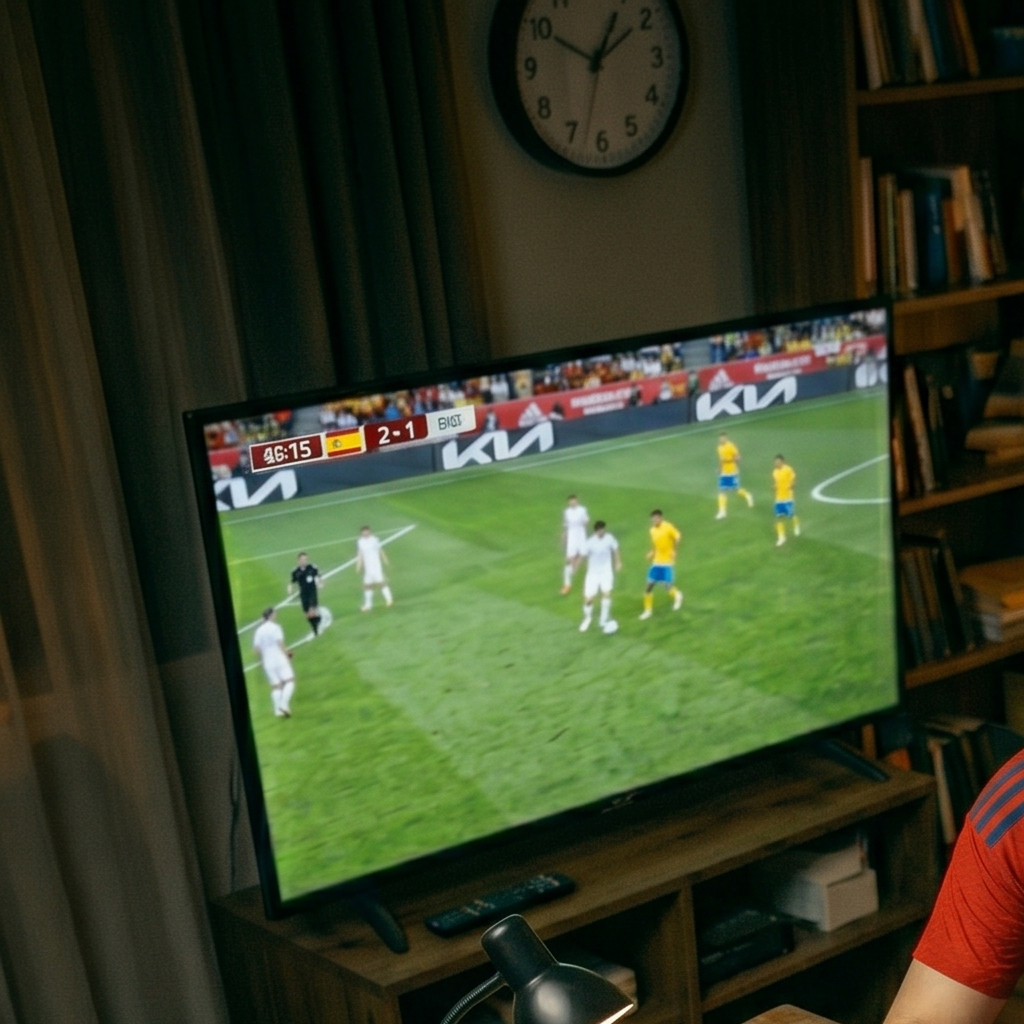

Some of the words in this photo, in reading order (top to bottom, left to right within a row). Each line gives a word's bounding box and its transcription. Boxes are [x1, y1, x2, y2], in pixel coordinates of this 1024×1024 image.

[530, 17, 552, 41] 10
[640, 8, 652, 31] 2
[524, 57, 537, 80] 9
[651, 46, 664, 69] 3
[645, 85, 658, 105] 4
[537, 96, 551, 120] 8
[565, 121, 578, 144] 7
[625, 115, 638, 137] 5
[597, 131, 609, 153] 6
